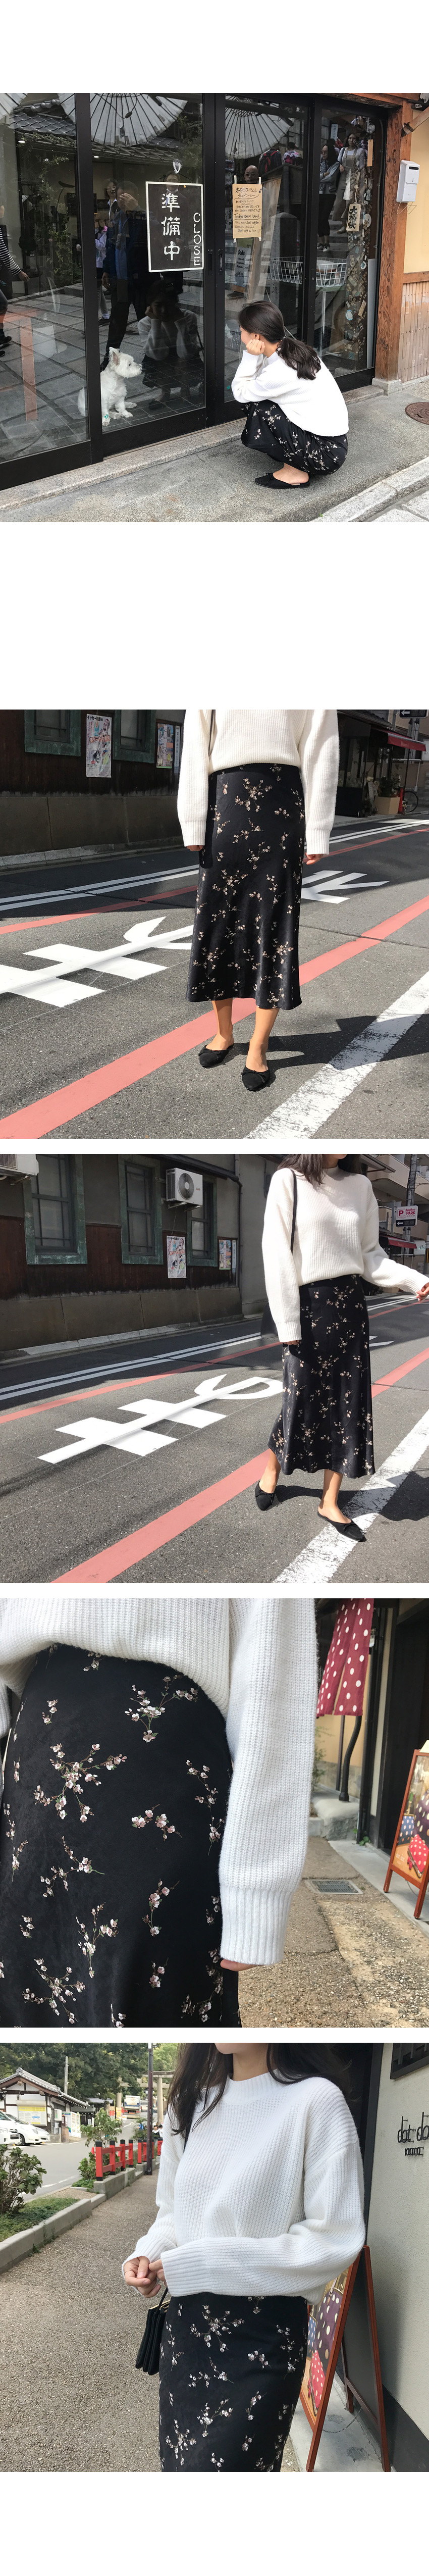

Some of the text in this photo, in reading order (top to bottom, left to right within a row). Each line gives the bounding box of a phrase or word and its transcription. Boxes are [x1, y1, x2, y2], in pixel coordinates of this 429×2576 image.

[161, 192, 180, 261] 準備中
[193, 212, 202, 266] CLOSE
[398, 2111, 429, 2143] dot do
